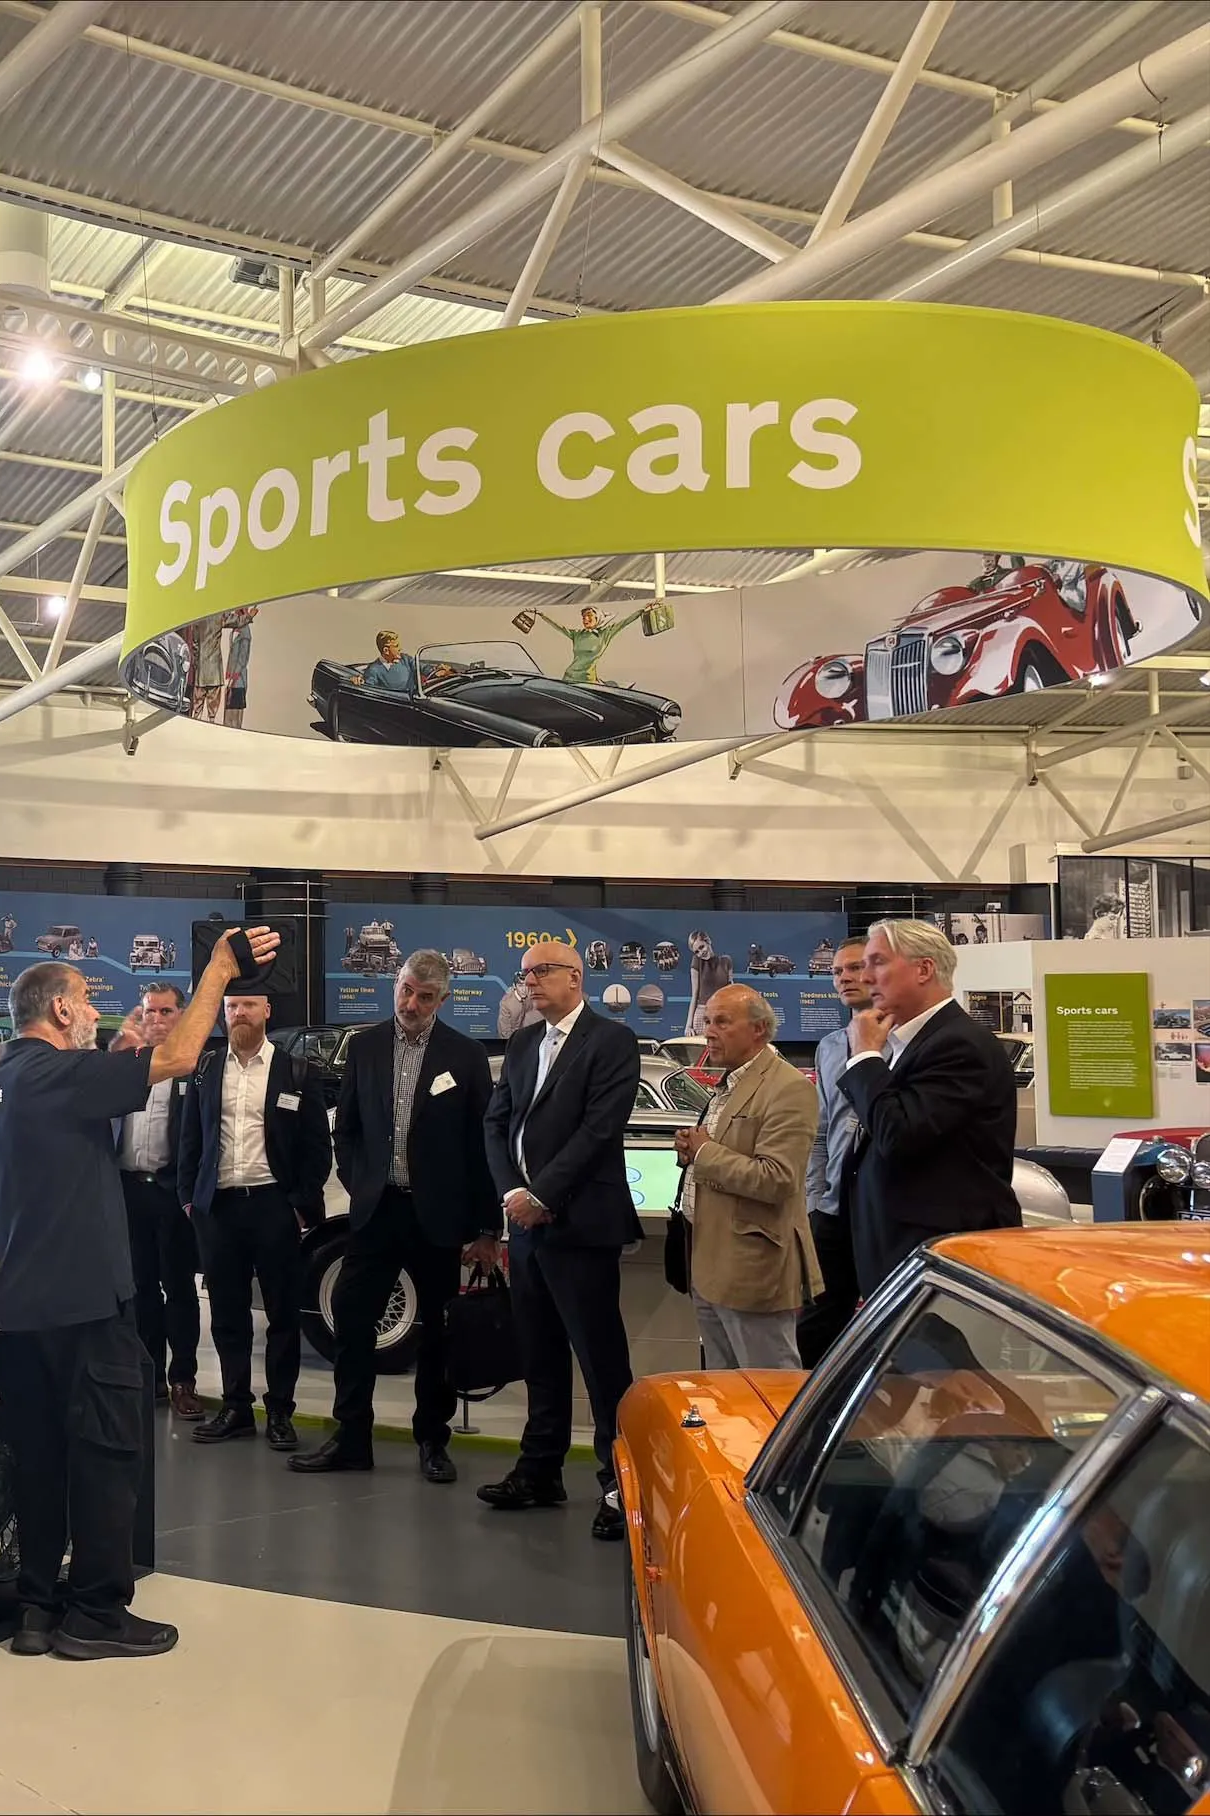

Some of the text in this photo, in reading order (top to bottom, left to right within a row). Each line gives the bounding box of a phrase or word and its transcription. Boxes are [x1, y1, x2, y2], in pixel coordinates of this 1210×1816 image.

[155, 398, 862, 591] Sports cars
[86, 984, 114, 992] rossings
[453, 988, 484, 996] Motorway
[1056, 1006, 1119, 1016] Sports cars
